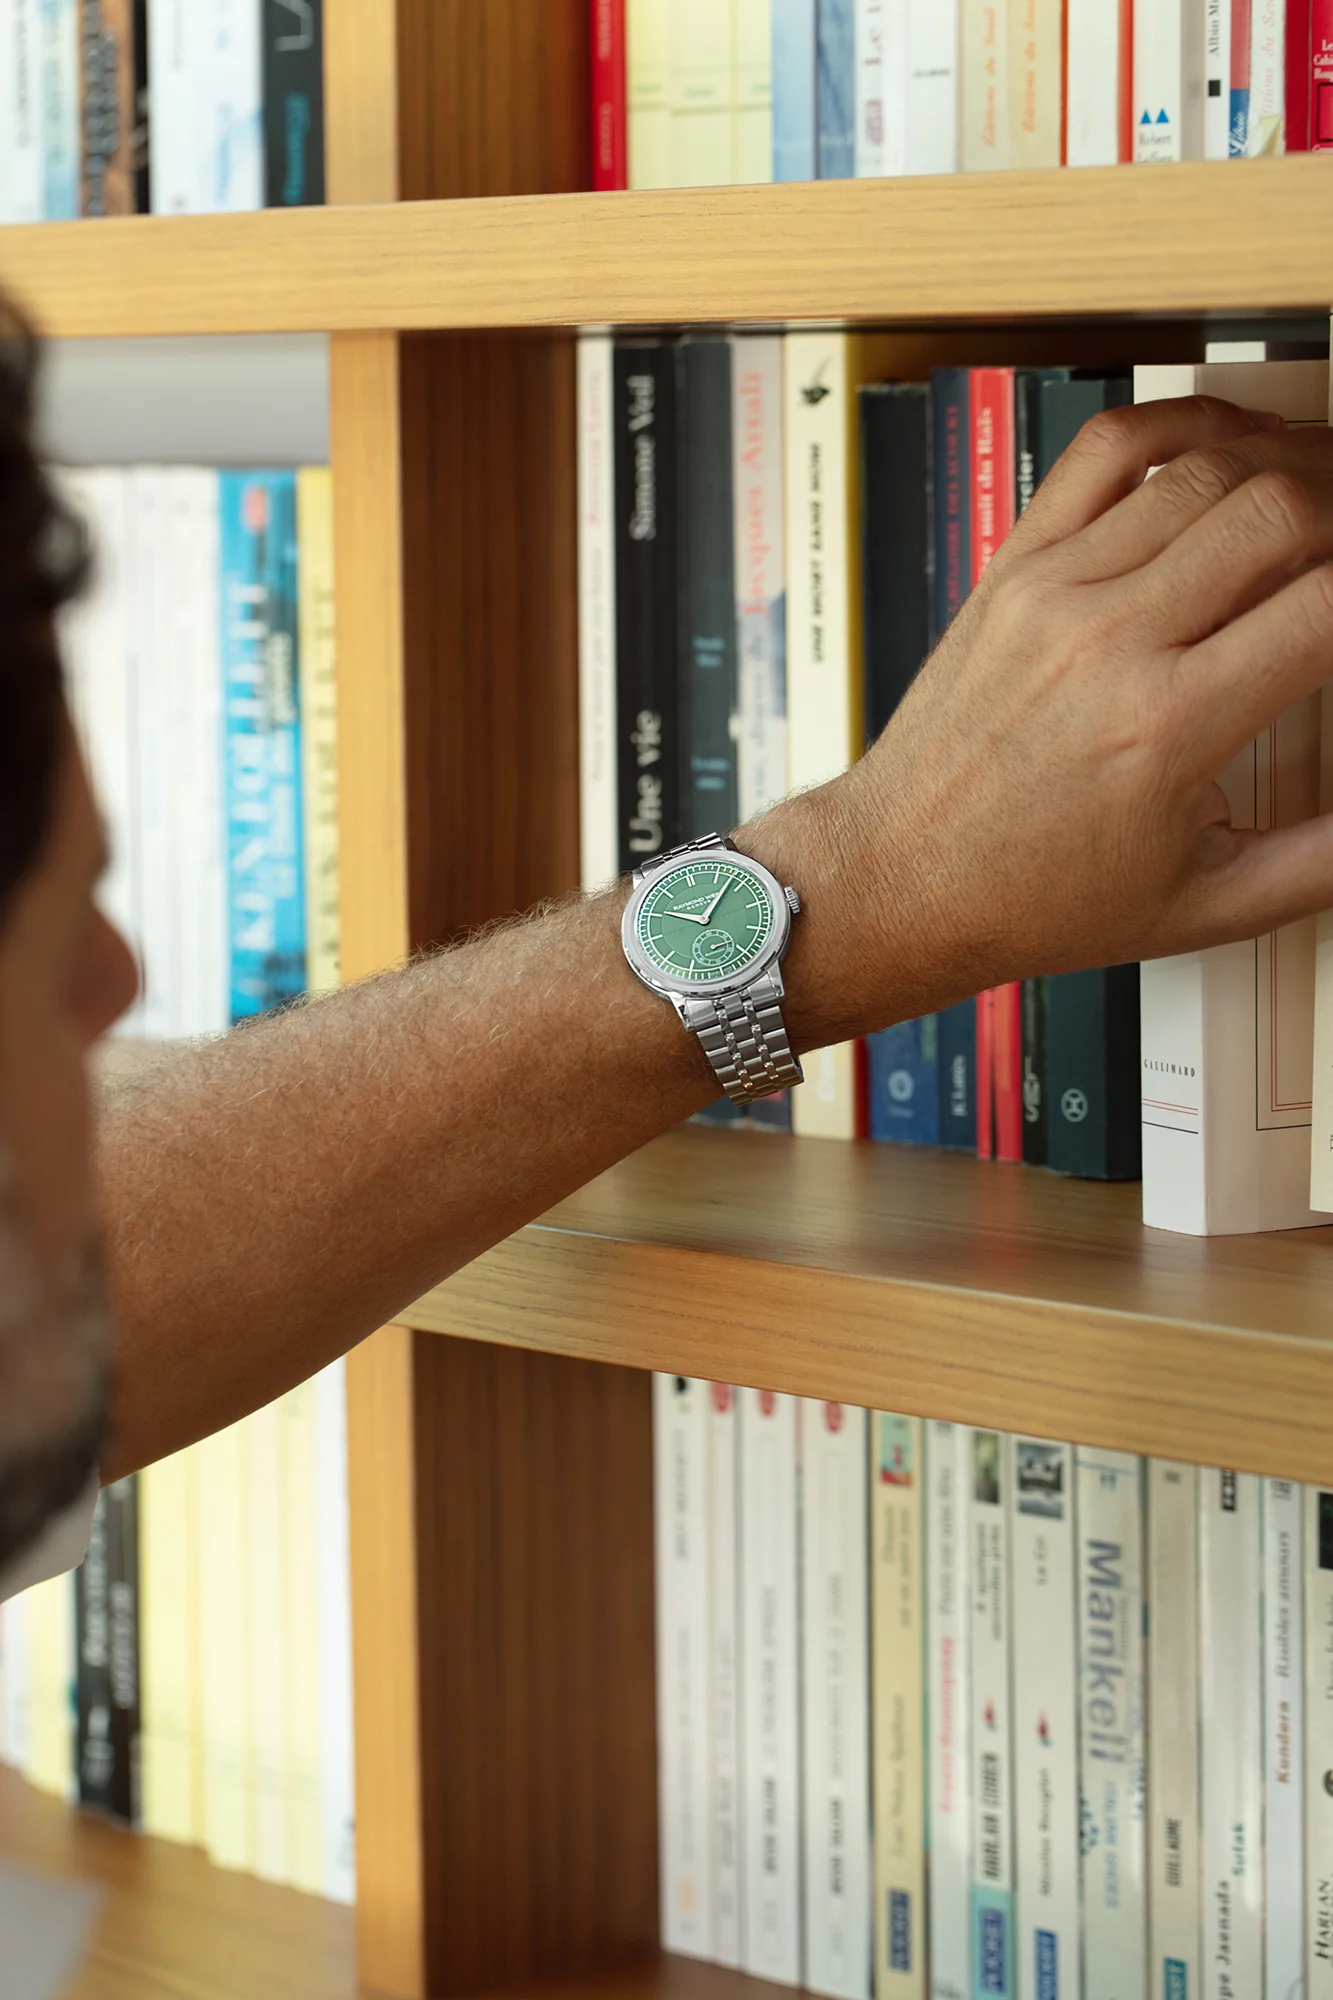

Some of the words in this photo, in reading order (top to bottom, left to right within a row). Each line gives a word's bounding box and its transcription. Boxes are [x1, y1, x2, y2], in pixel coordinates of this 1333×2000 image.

[1207, 20, 1220, 57] Albin
[739, 371, 763, 470] Attali
[979, 460, 994, 488] du
[979, 494, 994, 536] nuit
[740, 486, 771, 619] Jacques
[630, 709, 661, 767] vie
[629, 774, 662, 851] Une
[673, 896, 705, 911] RAYMOND
[1144, 1059, 1196, 1078] GALLIMARD
[1276, 1530, 1291, 1602] amours
[1086, 1540, 1129, 1764] Mankell
[1274, 1700, 1292, 1784] Kundera
[1164, 1817, 1183, 1888] GUILLAUME
[1230, 1822, 1246, 1877] Sulak
[1314, 1877, 1331, 1959] HARLAN
